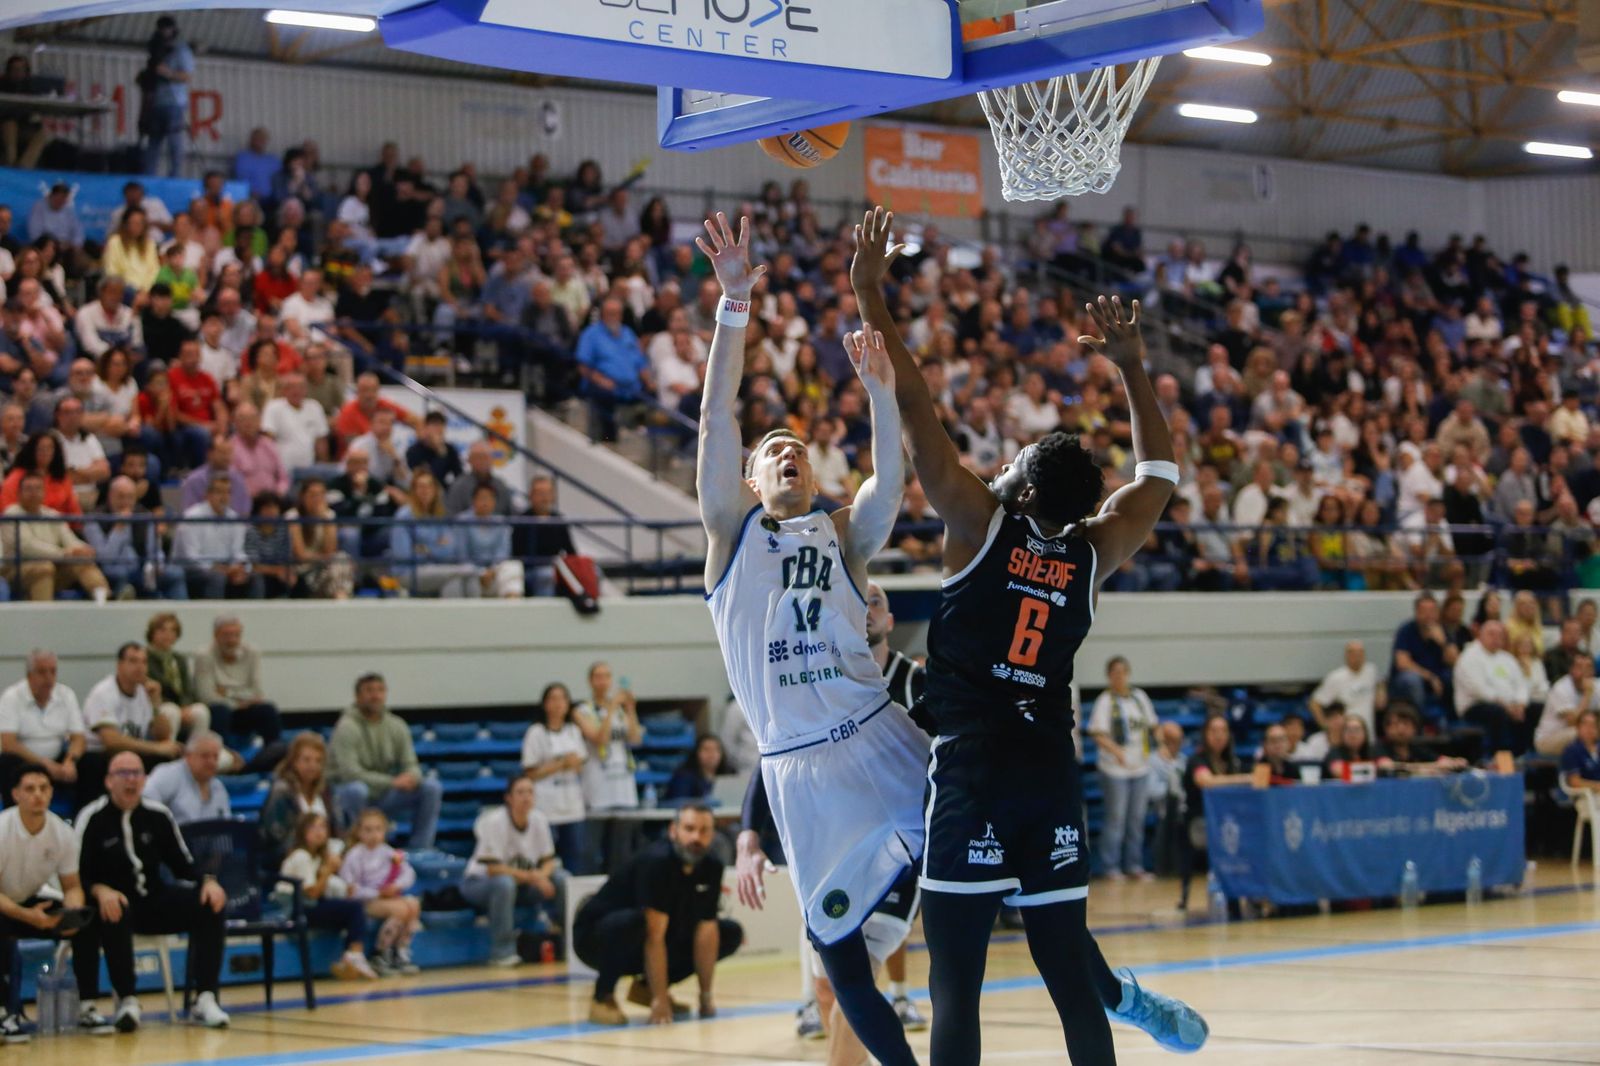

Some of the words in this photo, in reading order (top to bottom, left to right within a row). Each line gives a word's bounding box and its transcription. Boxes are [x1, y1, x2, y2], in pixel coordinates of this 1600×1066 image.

[628, 20, 787, 58] CENTER
[782, 545, 833, 591] CBA
[1007, 547, 1077, 590] SHERIF
[1006, 581, 1050, 599] fundación
[792, 598, 822, 632] 14
[1007, 597, 1050, 666] 6
[830, 720, 859, 743] CBA
